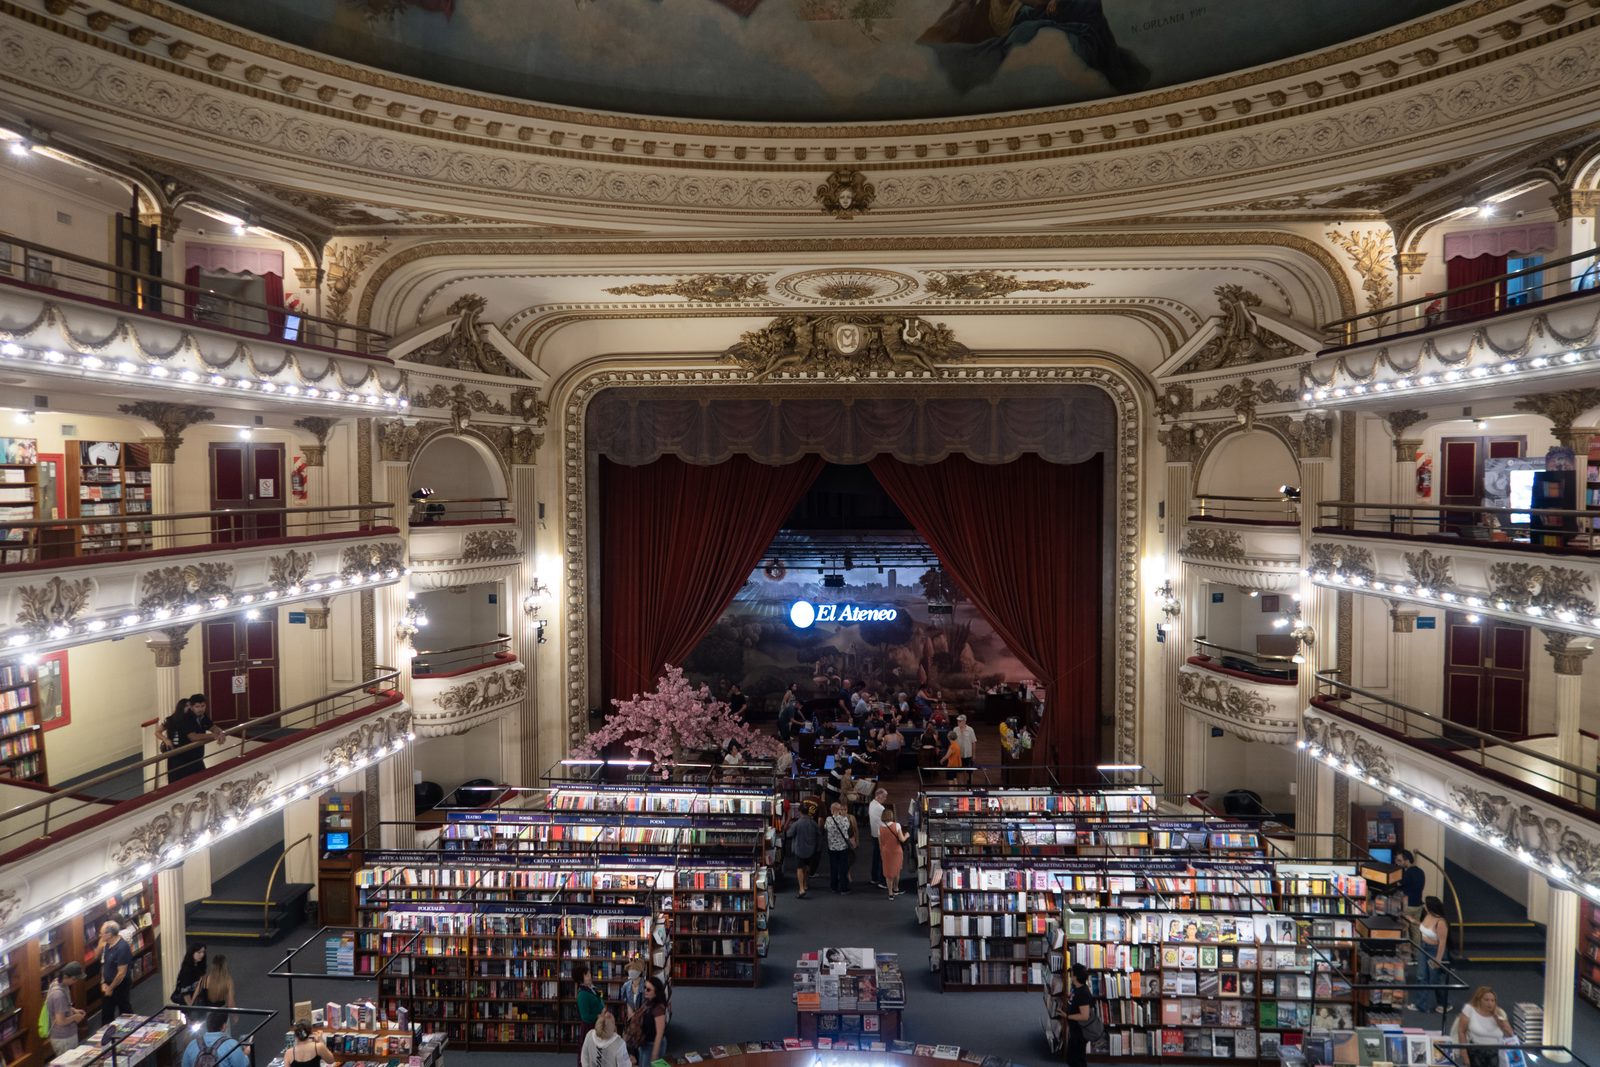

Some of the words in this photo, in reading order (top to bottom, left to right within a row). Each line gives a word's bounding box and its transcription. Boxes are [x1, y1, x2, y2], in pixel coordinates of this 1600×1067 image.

[1143, 12, 1184, 31] ORLANDI
[815, 604, 837, 621] El
[837, 604, 897, 621] Ateneo
